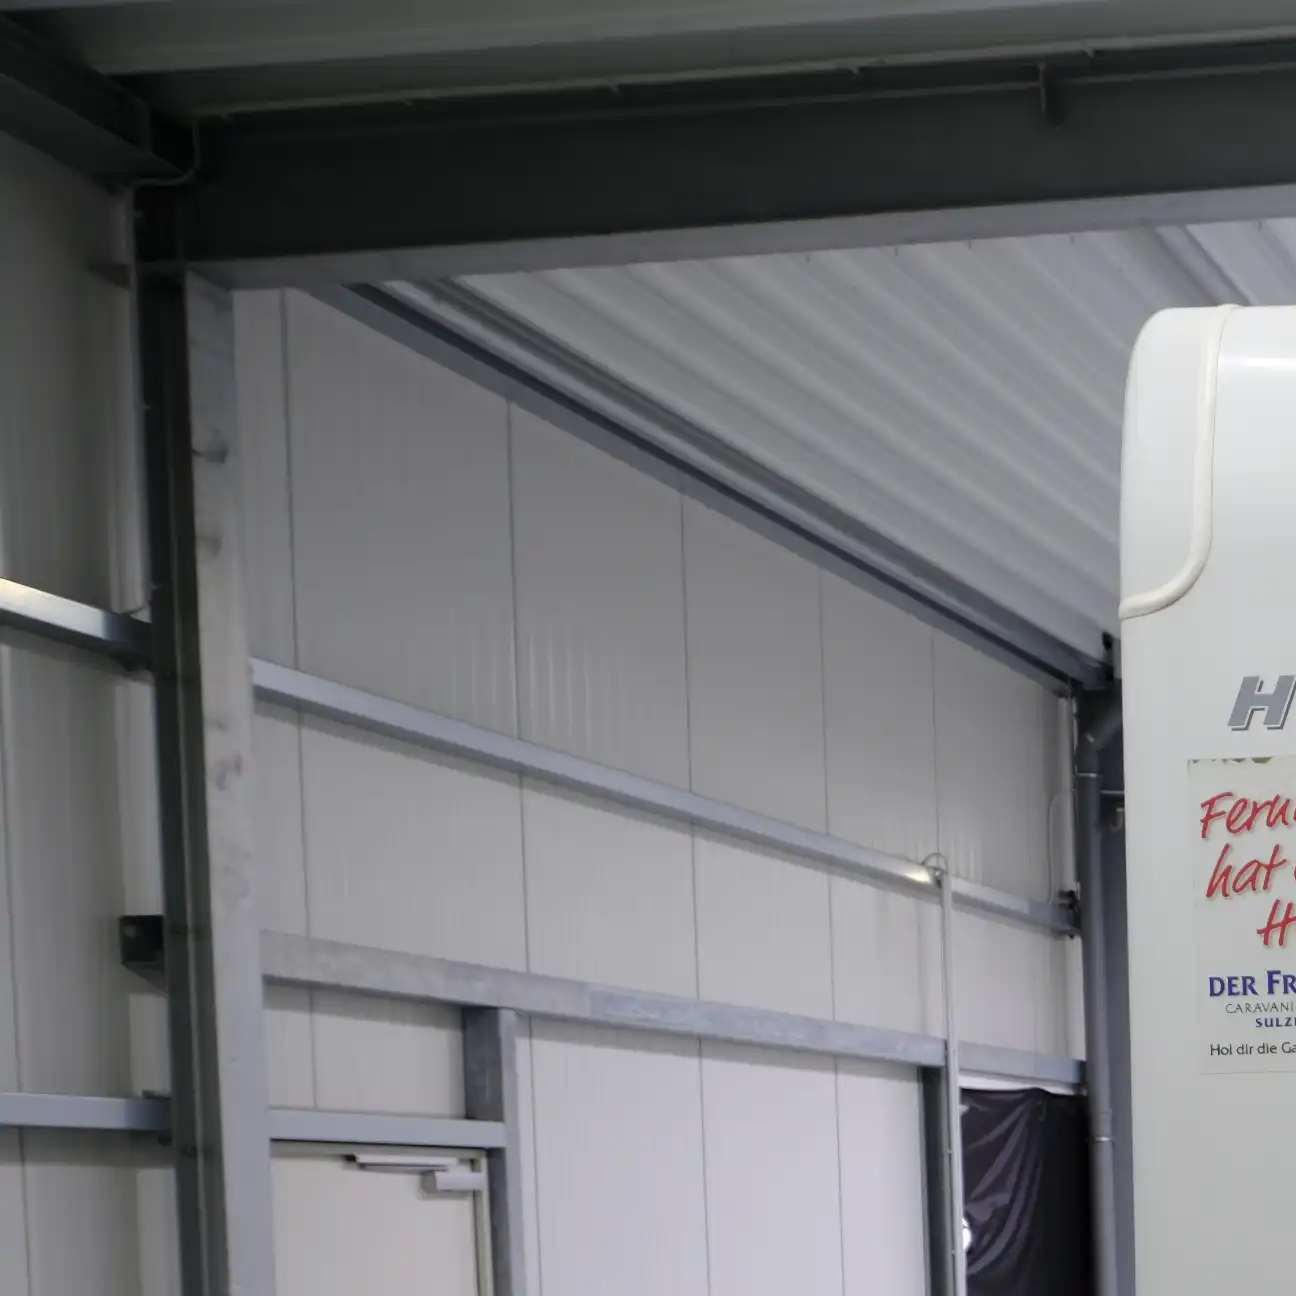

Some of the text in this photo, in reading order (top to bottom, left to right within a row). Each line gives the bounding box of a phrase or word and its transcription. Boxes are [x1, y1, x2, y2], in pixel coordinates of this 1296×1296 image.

[1206, 843, 1287, 898] hat
[1209, 976, 1259, 997] DER
[1210, 1043, 1232, 1056] Hol
[1236, 1043, 1254, 1055] dir
[1257, 1042, 1278, 1054] die
